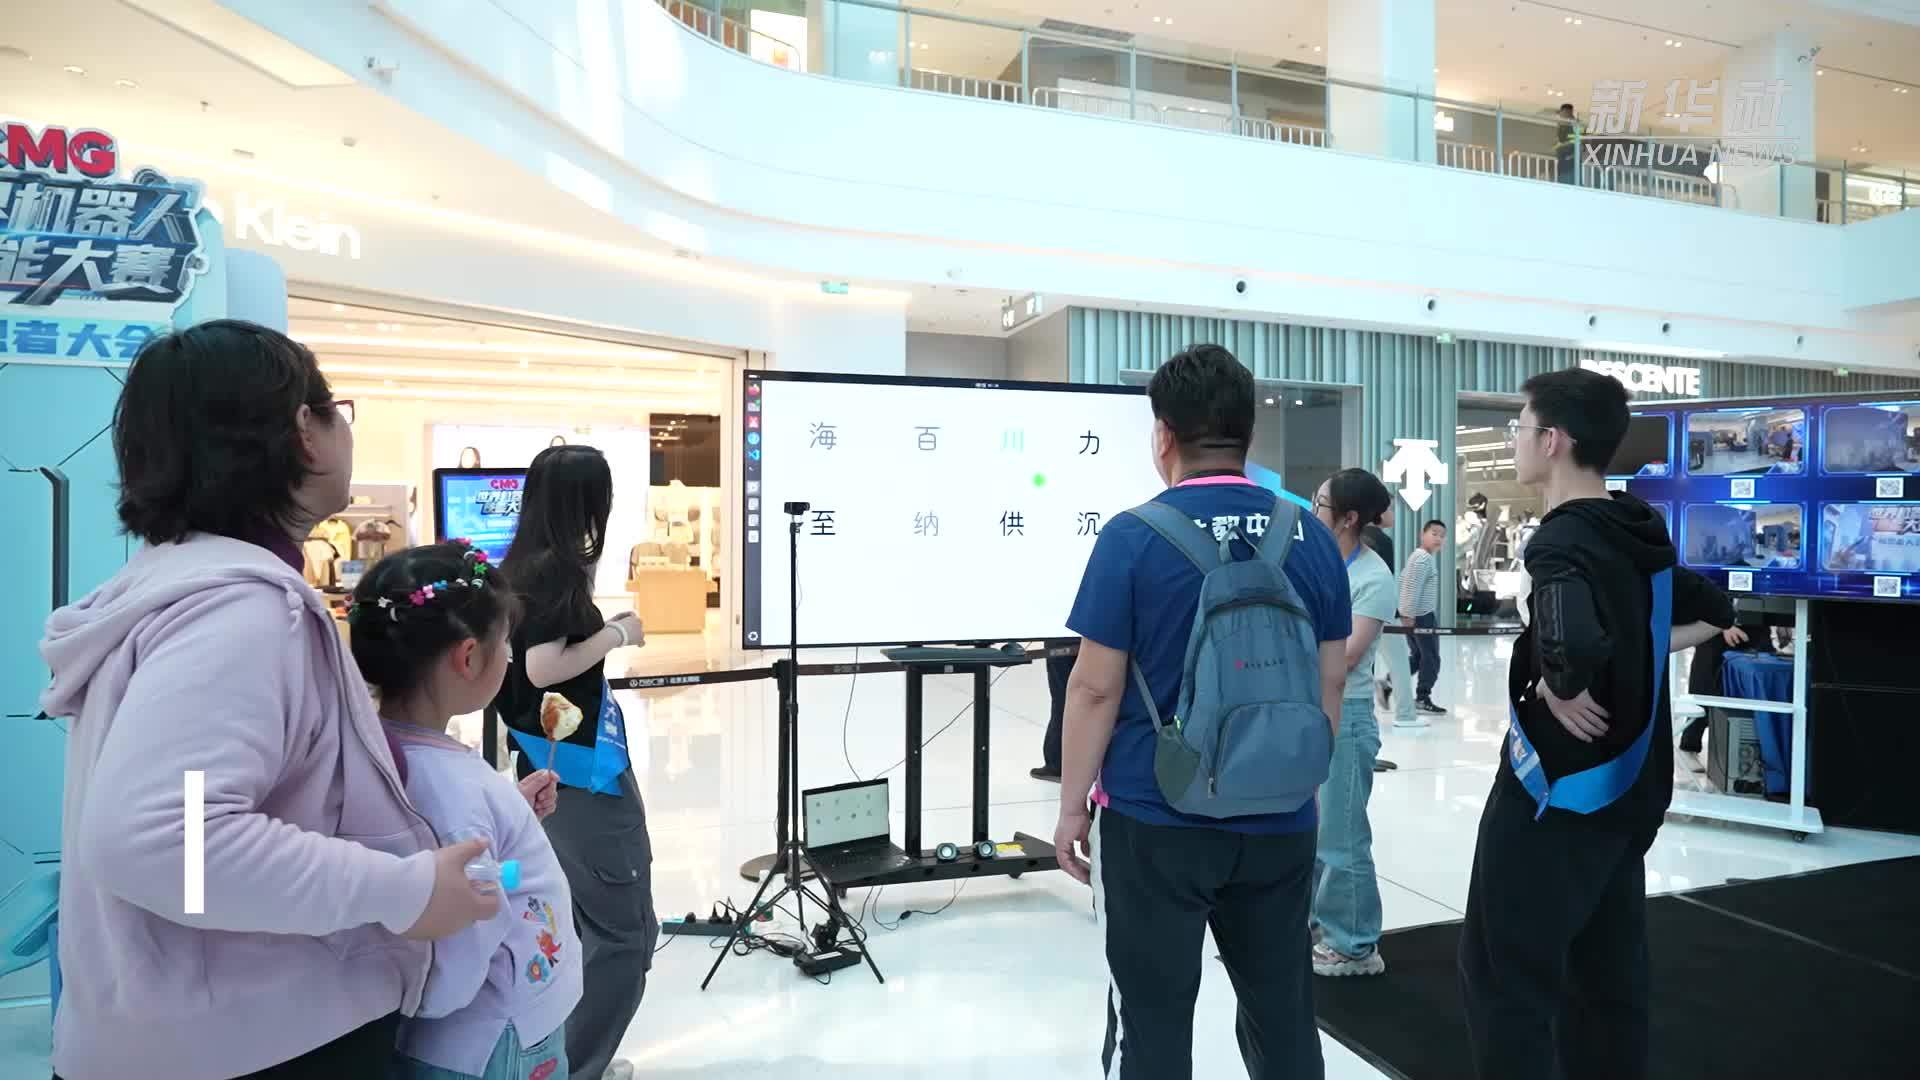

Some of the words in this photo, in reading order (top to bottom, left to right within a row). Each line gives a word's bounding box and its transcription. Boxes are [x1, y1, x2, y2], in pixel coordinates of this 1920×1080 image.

[0, 123, 117, 177] MG
[234, 193, 361, 260] Klein
[0, 319, 154, 358] 者大会
[809, 422, 838, 451] 海
[914, 425, 941, 452] 百
[1078, 429, 1100, 455] 力
[810, 510, 836, 537] 至
[913, 511, 940, 538] 纳
[999, 510, 1025, 538] 供
